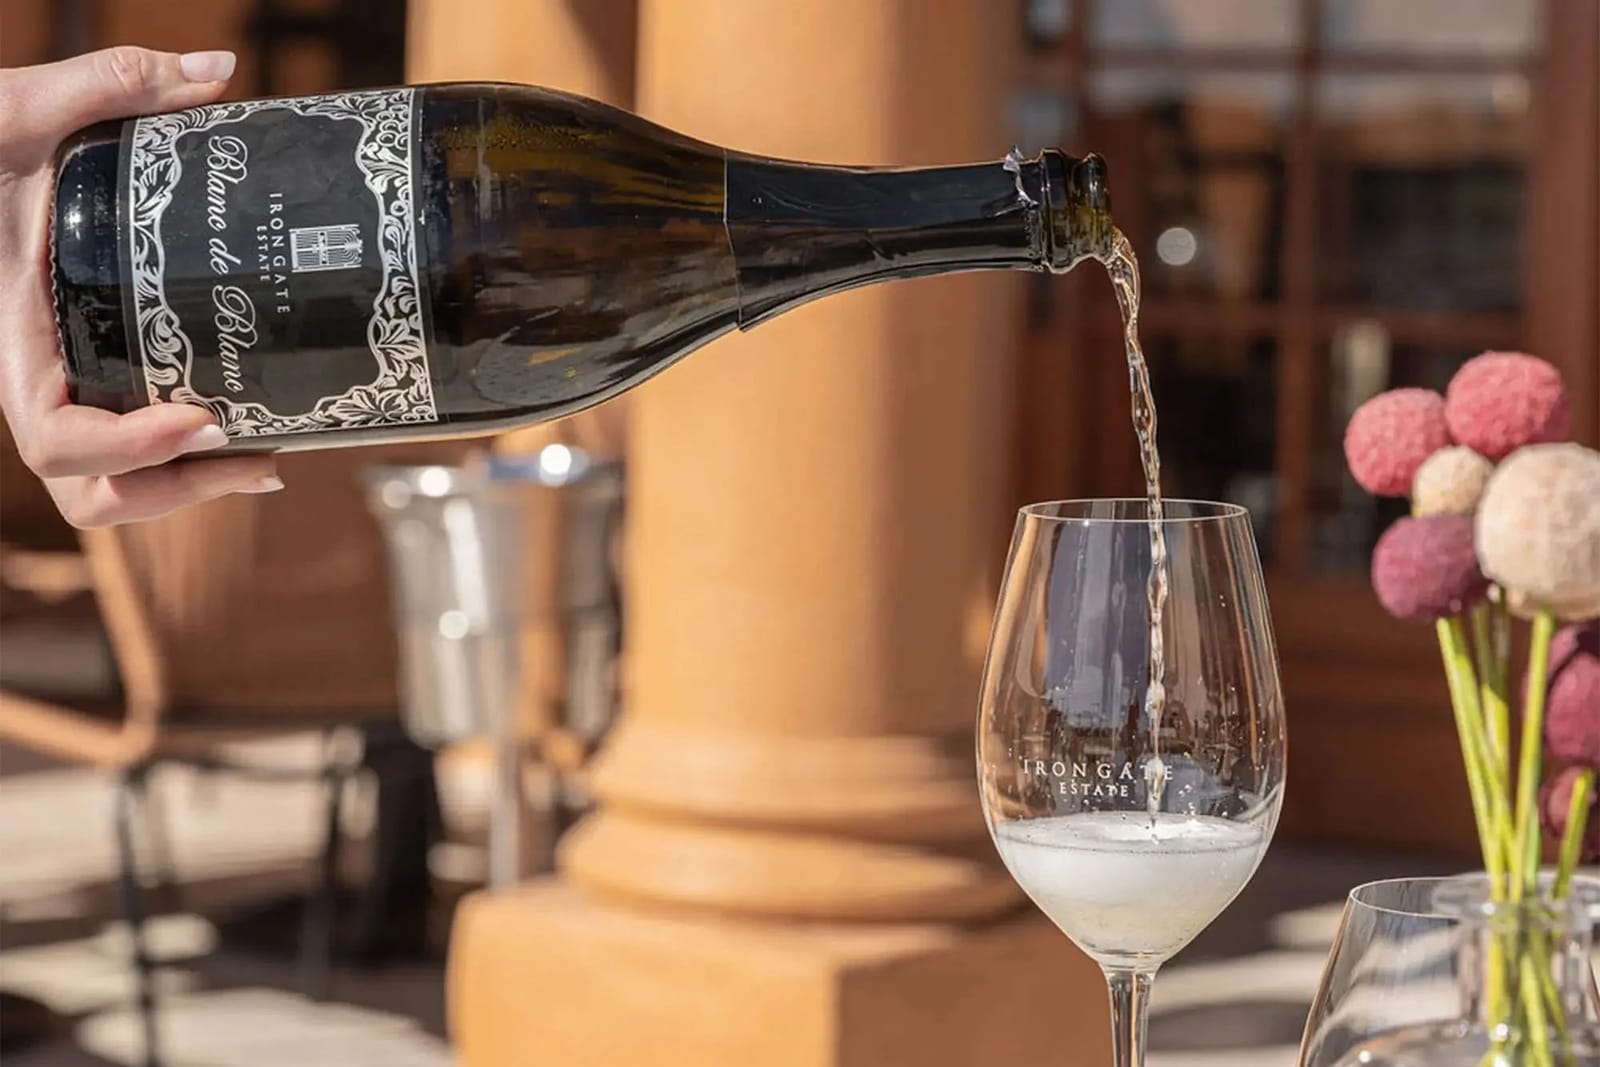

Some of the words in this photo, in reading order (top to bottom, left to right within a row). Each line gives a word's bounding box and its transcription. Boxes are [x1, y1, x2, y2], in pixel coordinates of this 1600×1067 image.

[206, 135, 249, 232] Blanc
[208, 237, 242, 276] de
[256, 225, 271, 281] ESTATE
[212, 284, 258, 393] Blanc
[1059, 781, 1129, 797] ESTATE
